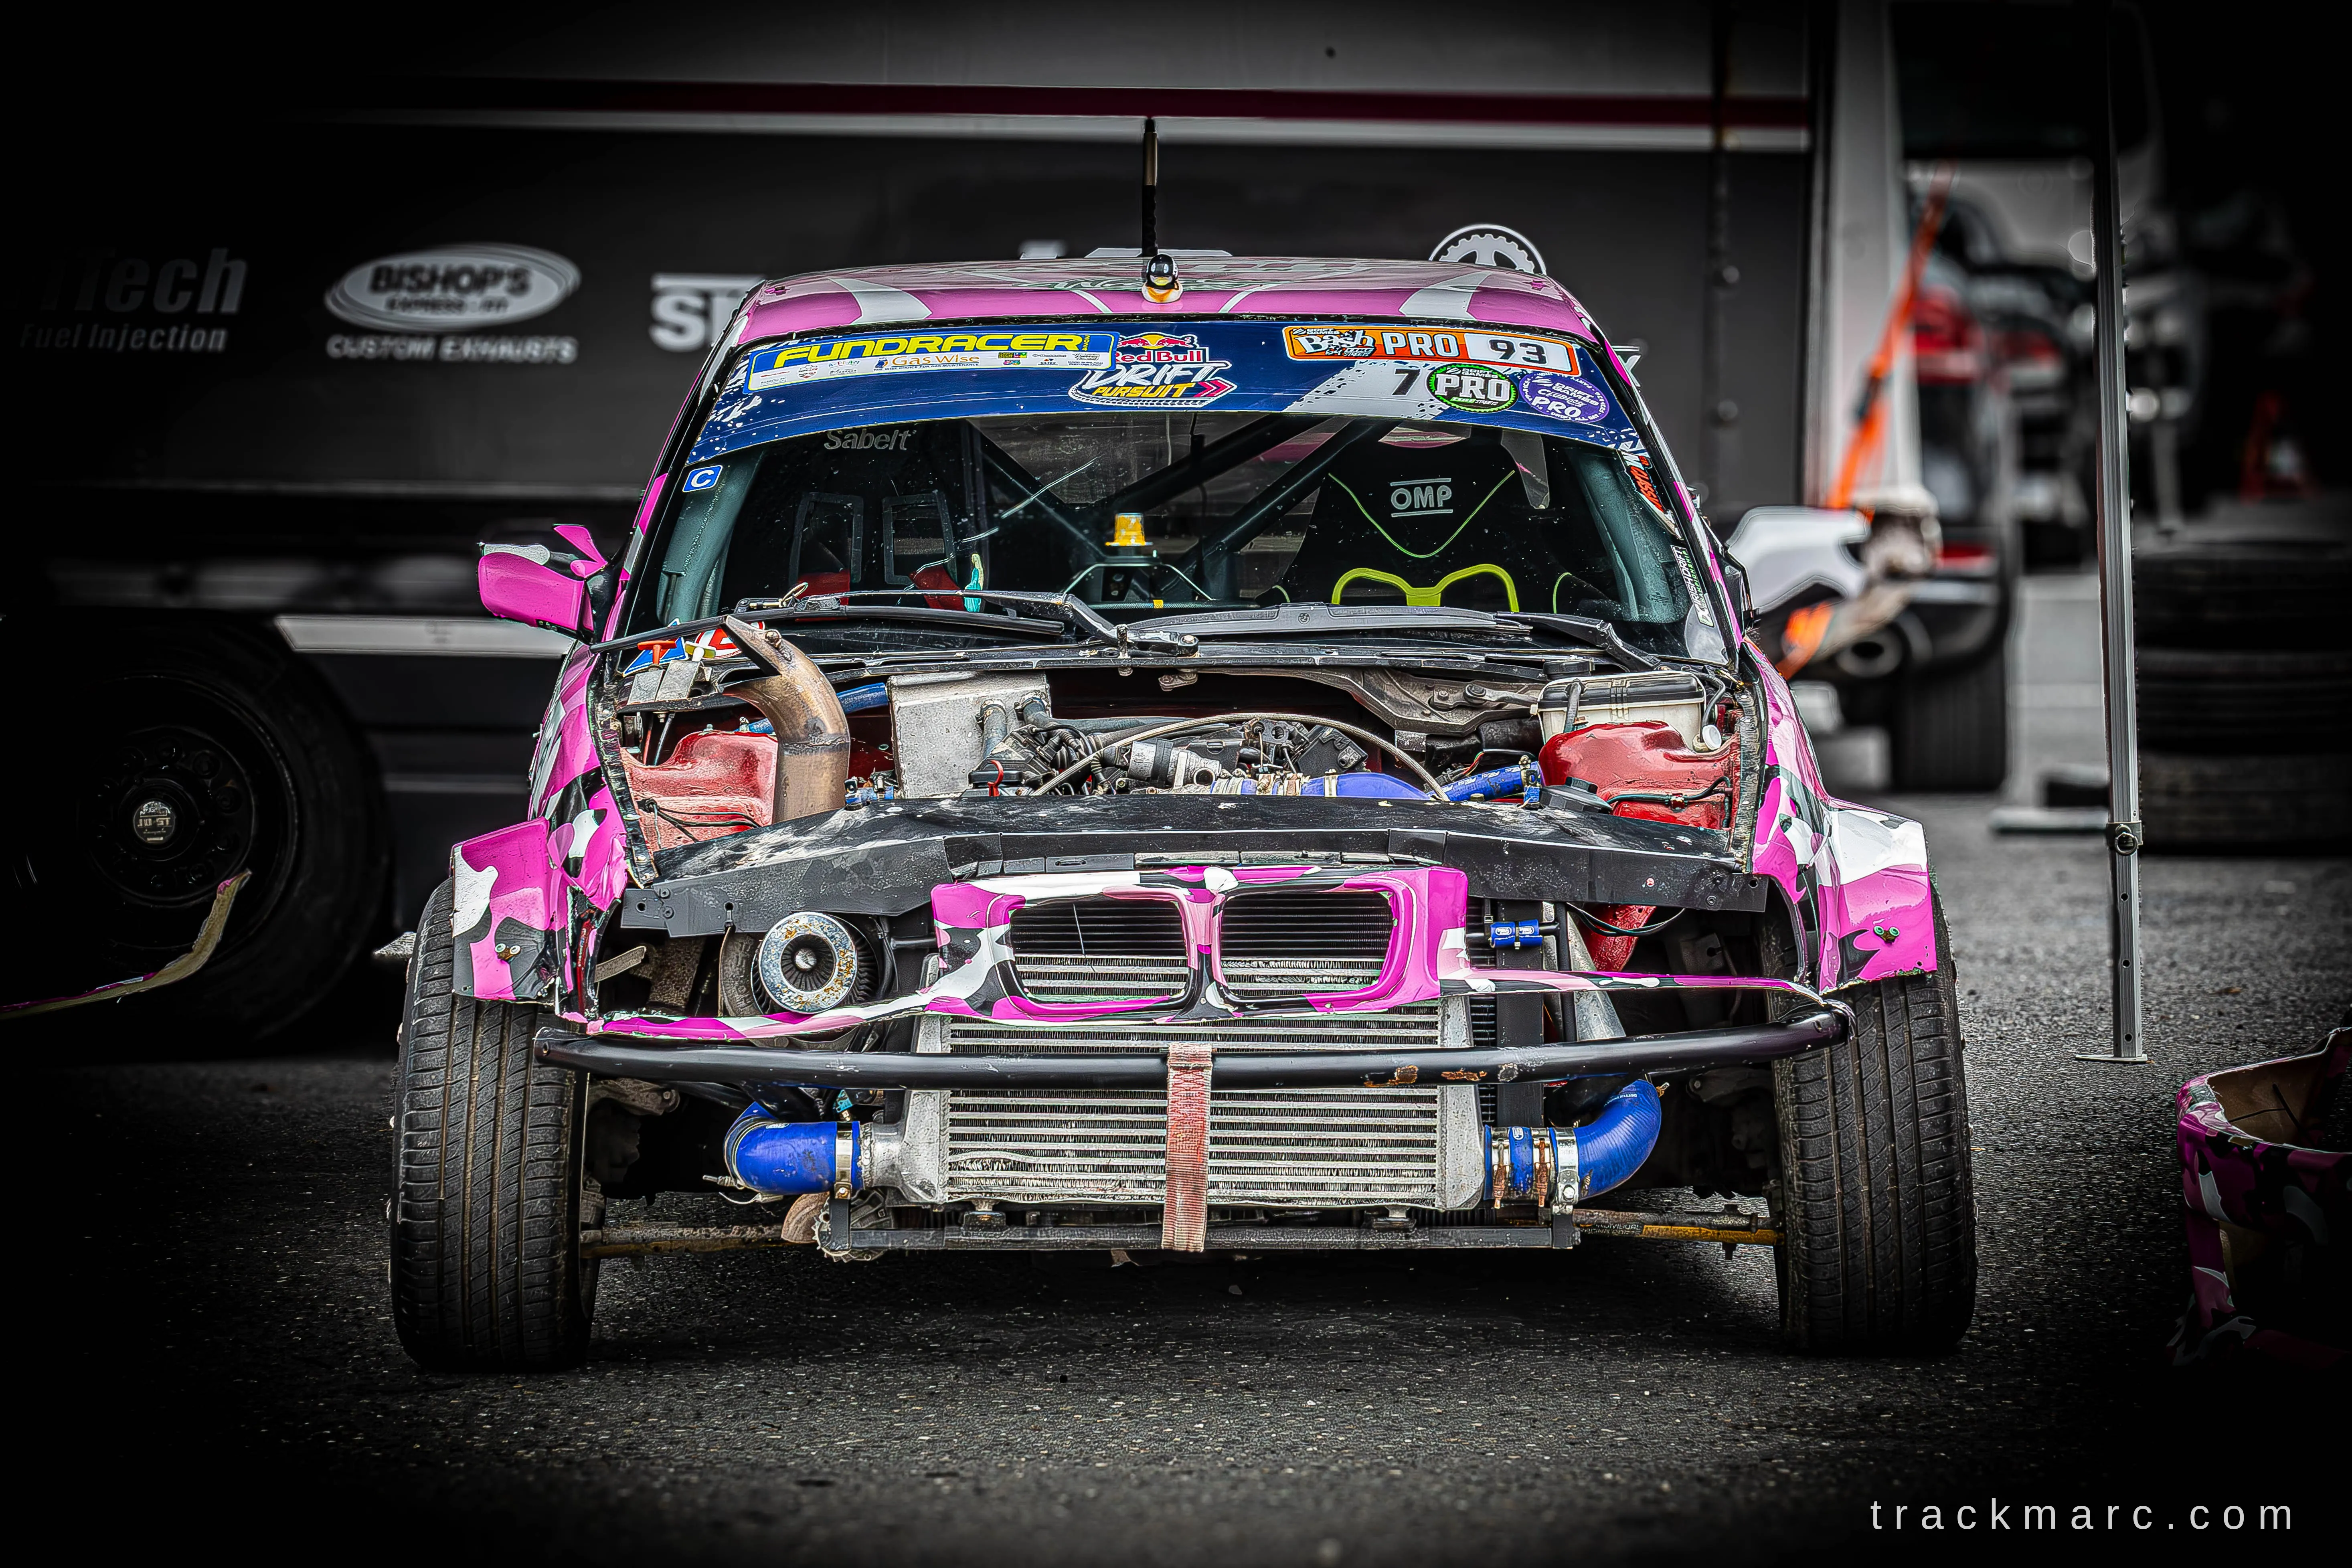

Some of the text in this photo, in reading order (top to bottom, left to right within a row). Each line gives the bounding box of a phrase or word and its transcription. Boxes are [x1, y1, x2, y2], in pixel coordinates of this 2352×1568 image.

[3, 245, 249, 315] iTech
[367, 264, 533, 297] BISHOP'S
[20, 323, 230, 353] Fuel Injection
[326, 334, 578, 364] CUSTOM EXHAUSTS
[774, 334, 1090, 368] FUNDRACER 2024
[1295, 330, 1547, 364] Bash PRO 93
[892, 354, 980, 366] Gas Wise
[1115, 350, 1202, 362] Red Bull
[1082, 363, 1227, 390] DRIFT
[1391, 368, 1421, 397] 7
[1435, 373, 1511, 402] PRO
[1092, 382, 1196, 398] PURSUIT
[1552, 386, 1599, 406] GAMES
[1555, 382, 1594, 399] DRIFT
[1531, 396, 1581, 418] PRO
[824, 429, 911, 451] Sabelt
[690, 469, 715, 488] C
[1391, 485, 1452, 510] OMP
